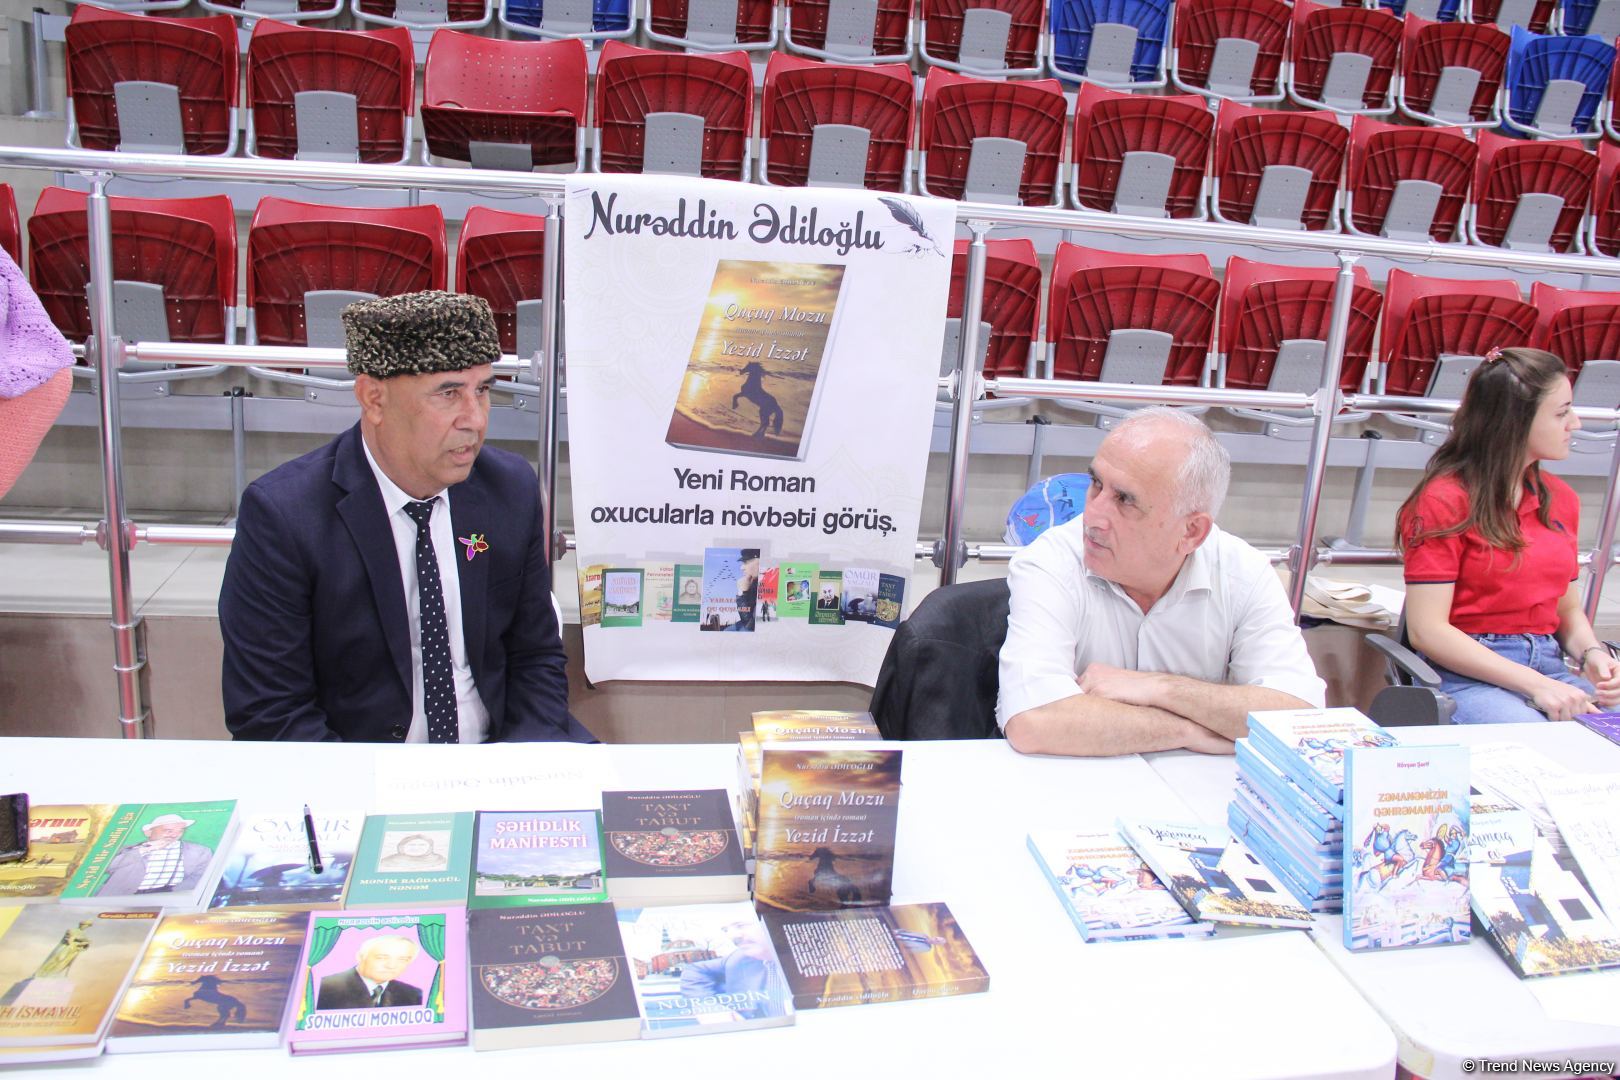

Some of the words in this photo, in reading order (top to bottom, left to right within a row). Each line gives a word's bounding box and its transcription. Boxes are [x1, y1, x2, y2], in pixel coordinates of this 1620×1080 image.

[584, 191, 739, 240] Nurəddin
[748, 203, 885, 256] Ədiloğlu
[779, 306, 826, 323] Mozu
[721, 340, 764, 358] Yezid
[767, 340, 809, 361] İzzət
[674, 467, 723, 490] Yeni
[731, 470, 816, 493] Roman
[590, 503, 714, 525] oxucularla
[722, 506, 816, 529] növbəti
[823, 508, 898, 537] görüş.
[825, 726, 866, 735] Mozu
[641, 803, 692, 813] TAXT
[780, 790, 833, 810] Qaçaq
[837, 791, 885, 806] Mozu
[495, 818, 581, 836] ŞƏHİDLİK
[635, 817, 702, 826] TABUT
[490, 834, 588, 849] MANİFESTİ
[785, 828, 829, 843] Yezid
[833, 824, 875, 843] İzzət
[516, 922, 574, 936] TAXT
[232, 935, 287, 946] Mozu
[509, 940, 587, 956] TABUT
[167, 961, 218, 973] Yezid
[221, 958, 272, 973] İzzət
[657, 990, 770, 1011] NURƏDDİN
[307, 1013, 367, 1030] SONUNCU
[371, 1009, 433, 1026] MONOLOQ
